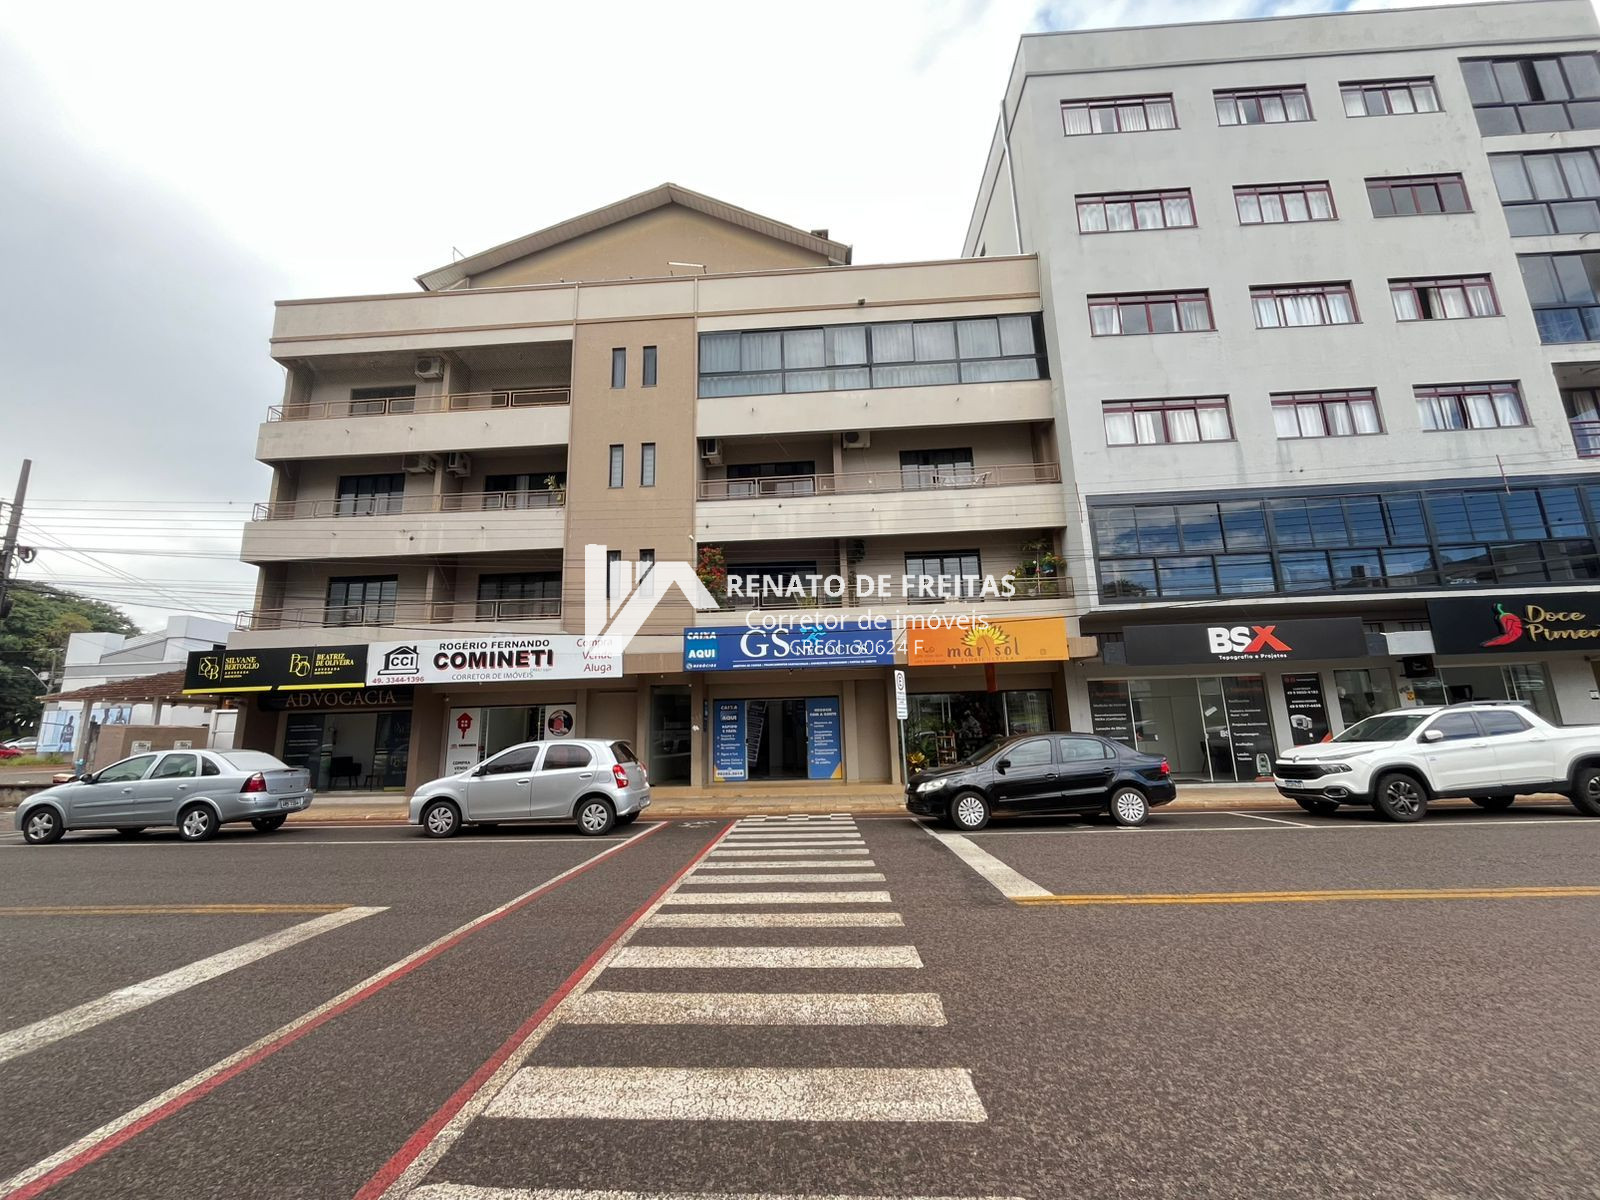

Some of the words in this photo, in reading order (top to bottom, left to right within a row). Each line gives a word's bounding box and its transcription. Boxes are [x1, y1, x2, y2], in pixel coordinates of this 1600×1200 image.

[1522, 604, 1586, 623] Doce
[687, 631, 717, 640] CAIXA
[1207, 625, 1293, 653] BSX
[439, 640, 488, 651] ROGÉRIO
[491, 639, 550, 649] FERNANDO
[740, 628, 790, 657] GS
[688, 649, 716, 658] AQUI
[225, 656, 257, 664] SILVANE
[325, 659, 354, 667] OLIVEIRA
[390, 656, 414, 667] CCI
[433, 649, 554, 671] COMINETI
[583, 663, 612, 674] Aluga
[386, 676, 425, 684] 3344-1396
[451, 672, 490, 681] CORRETOR
[492, 672, 501, 680] DE
[503, 671, 534, 680] IMÓVEIS
[285, 690, 396, 707] ADVOCACIA
